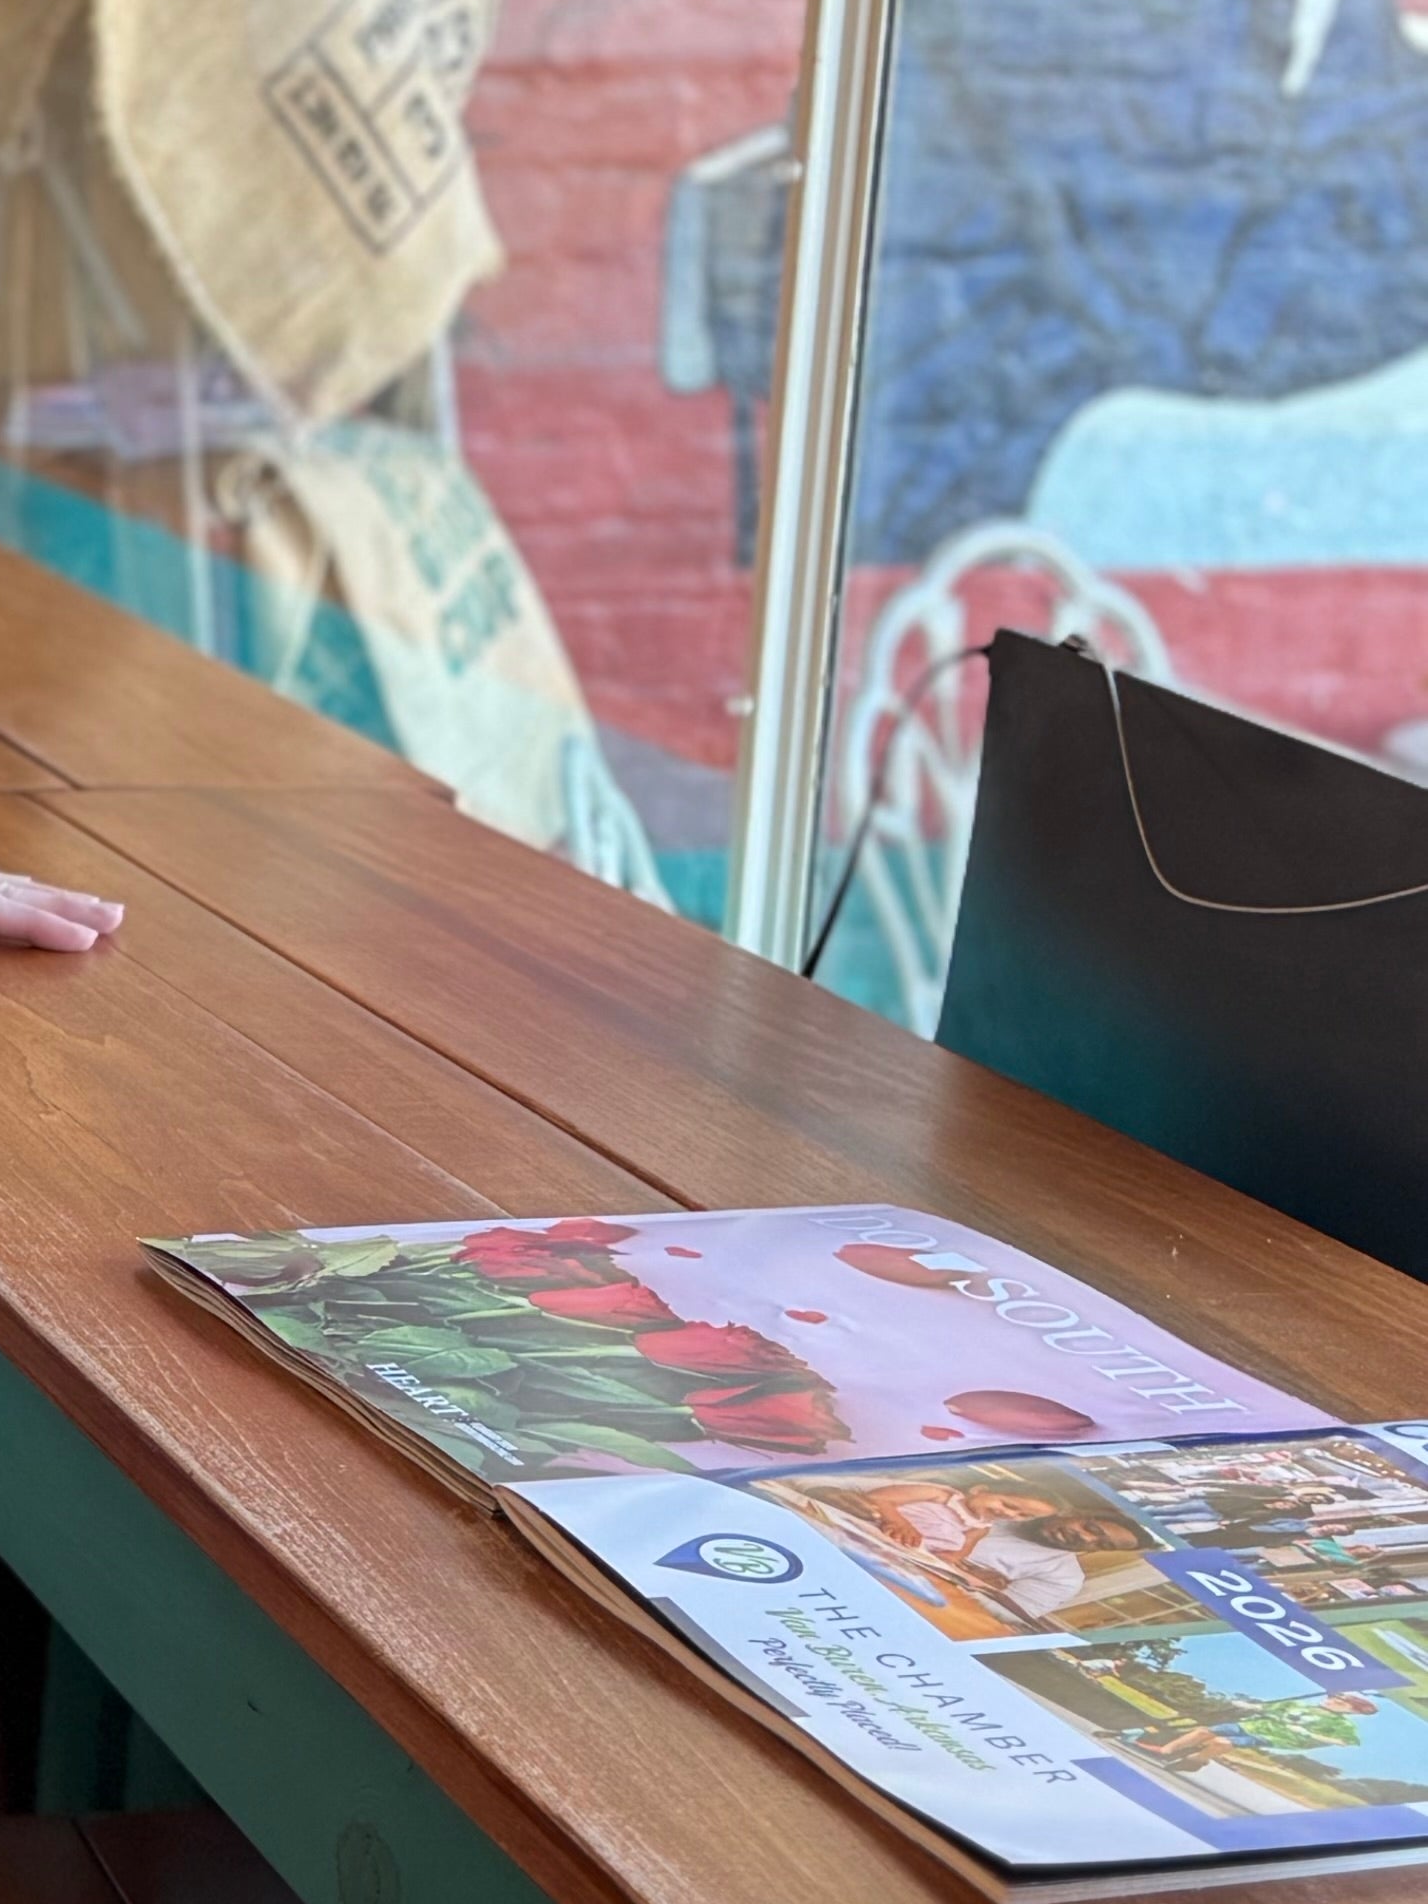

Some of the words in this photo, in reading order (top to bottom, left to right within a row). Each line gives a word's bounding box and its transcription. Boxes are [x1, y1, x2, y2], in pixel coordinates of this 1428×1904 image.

[809, 1214, 939, 1250] DO
[950, 1276, 1252, 1417] SOUTH
[365, 1362, 470, 1416] HEART
[747, 1636, 844, 1698] Perfectly
[798, 1587, 882, 1640] THE
[876, 1653, 1078, 1784] CHAMBER
[1186, 1568, 1366, 1672] 2026
[764, 1606, 821, 1639] Van
[872, 1696, 998, 1771] Arkansas
